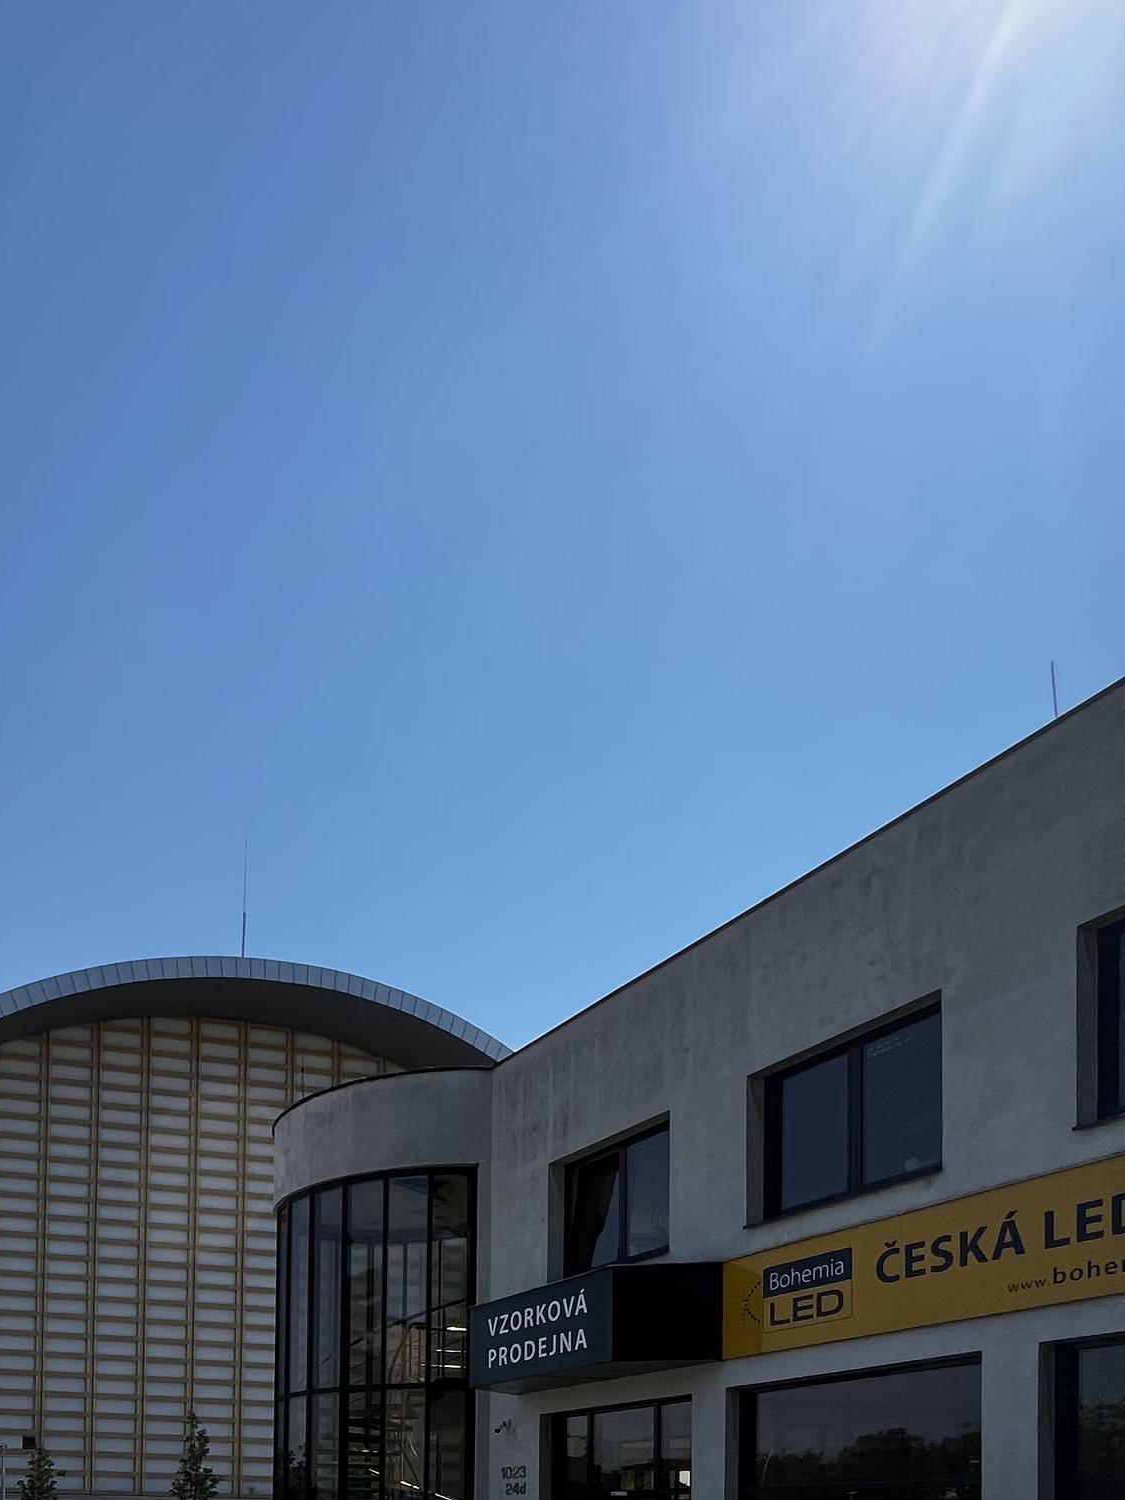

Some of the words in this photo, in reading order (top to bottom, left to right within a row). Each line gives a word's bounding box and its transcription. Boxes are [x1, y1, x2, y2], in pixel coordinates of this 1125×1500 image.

[876, 1210, 1025, 1283] ČESKÁ
[769, 1258, 845, 1291] Bohemia
[1007, 1259, 1125, 1293] www.bohe
[486, 1288, 589, 1337] VZORKOVÁ
[769, 1289, 844, 1327] LED
[487, 1327, 589, 1369] PRODEJNA
[500, 1465, 527, 1479] 1023
[505, 1482, 527, 1496] 24d
